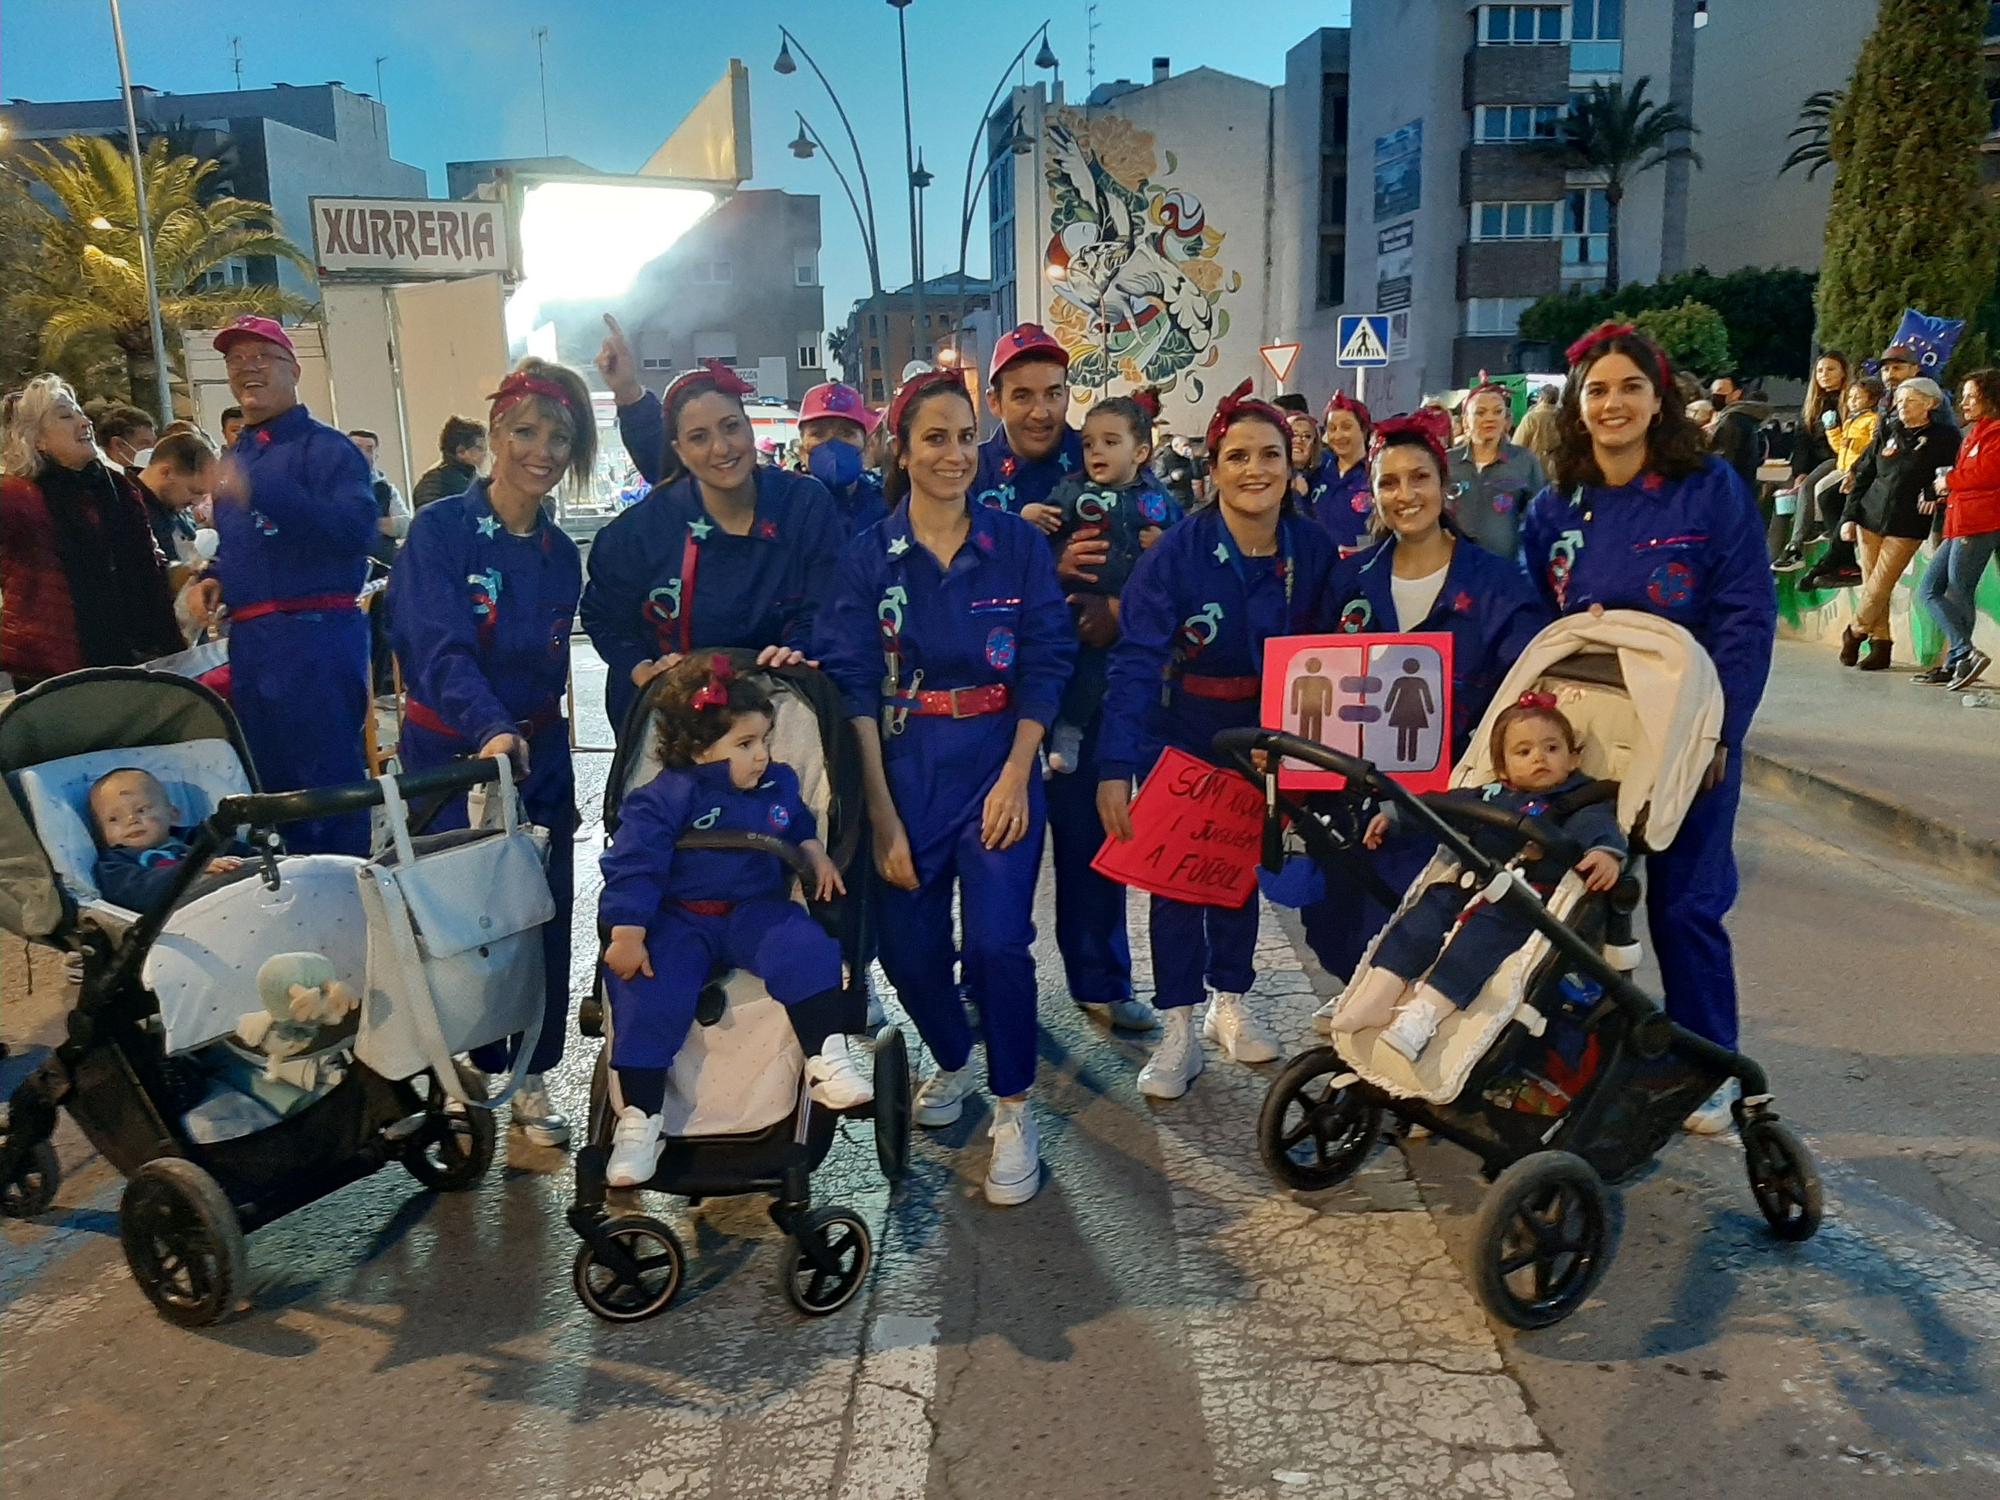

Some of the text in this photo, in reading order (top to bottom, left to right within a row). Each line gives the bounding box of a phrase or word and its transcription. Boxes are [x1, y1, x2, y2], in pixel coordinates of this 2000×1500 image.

[321, 207, 495, 262] XURRERIA
[1168, 766, 1228, 809] SOM
[1170, 815, 1183, 832] I
[1145, 844, 1243, 890] A FUTBOL
